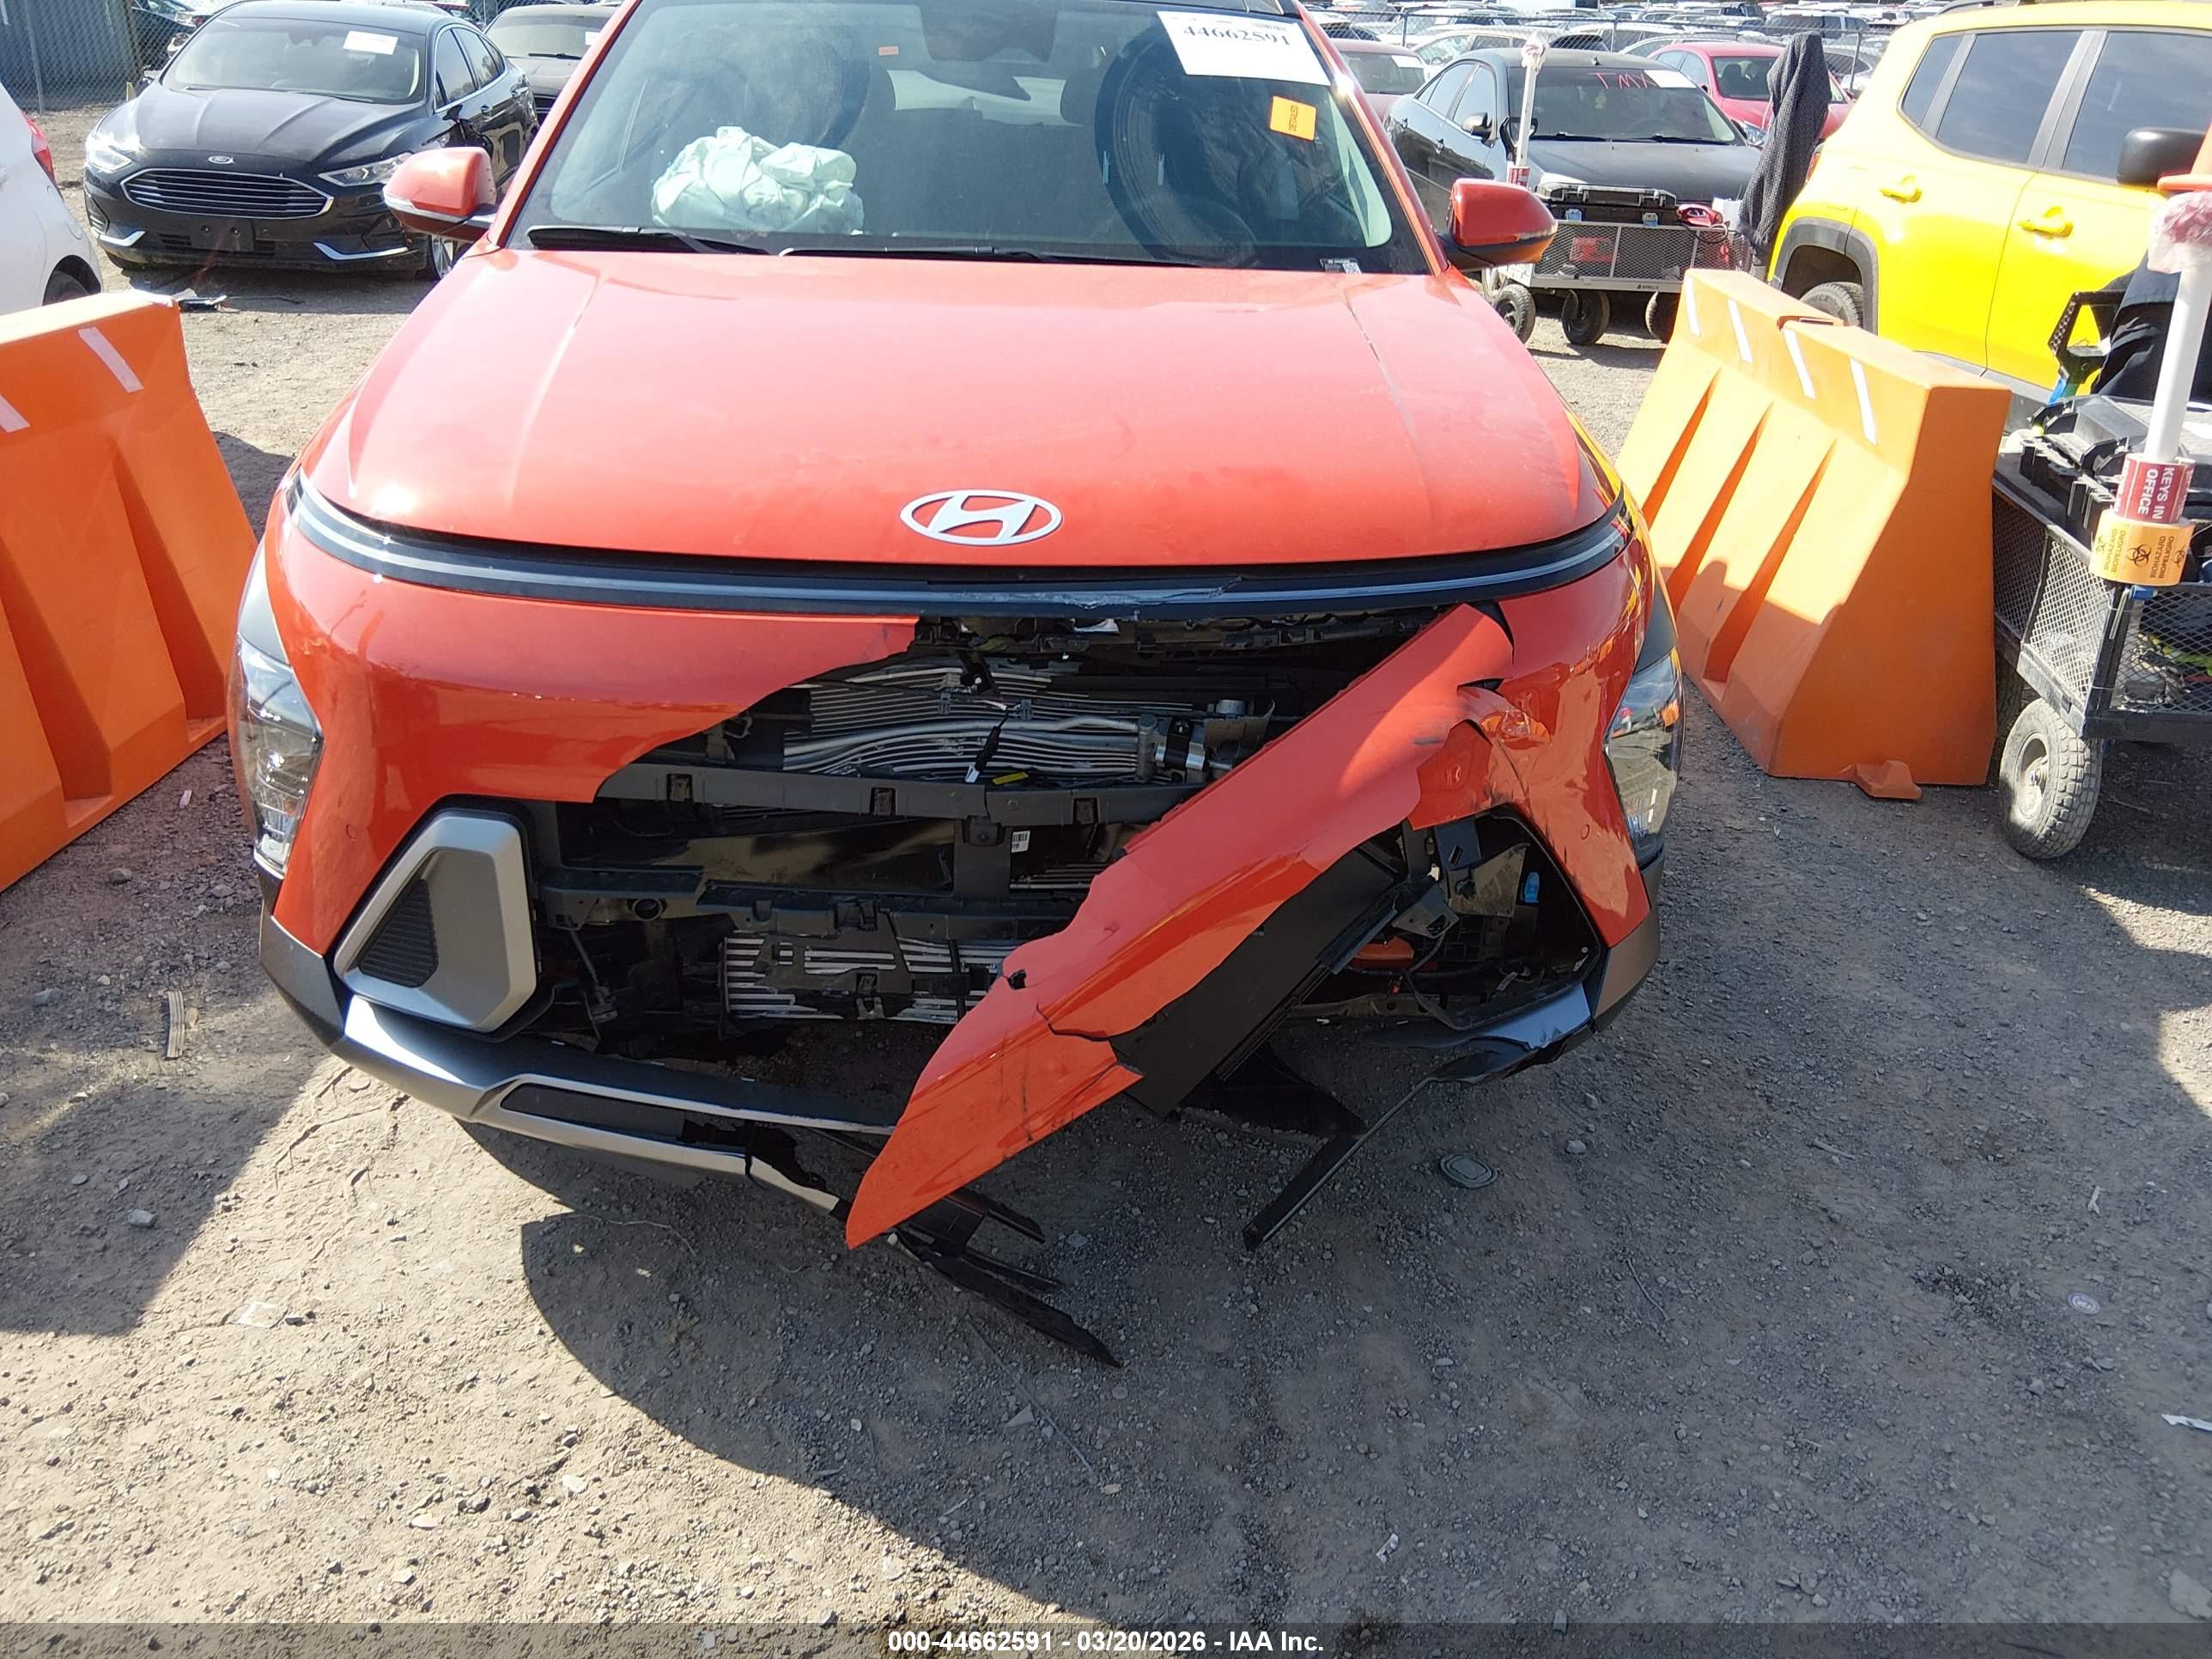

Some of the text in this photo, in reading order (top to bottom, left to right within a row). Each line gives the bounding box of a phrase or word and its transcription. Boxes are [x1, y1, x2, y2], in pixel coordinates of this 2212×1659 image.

[1183, 26, 1290, 46] 44662591
[2137, 468, 2159, 515] OFFICE
[2152, 467, 2175, 520] KEYS IN
[2104, 529, 2118, 570] BIOHAZARD
[2149, 535, 2166, 578] BIOHAZARD
[2158, 535, 2175, 579] BIOPELIGRO
